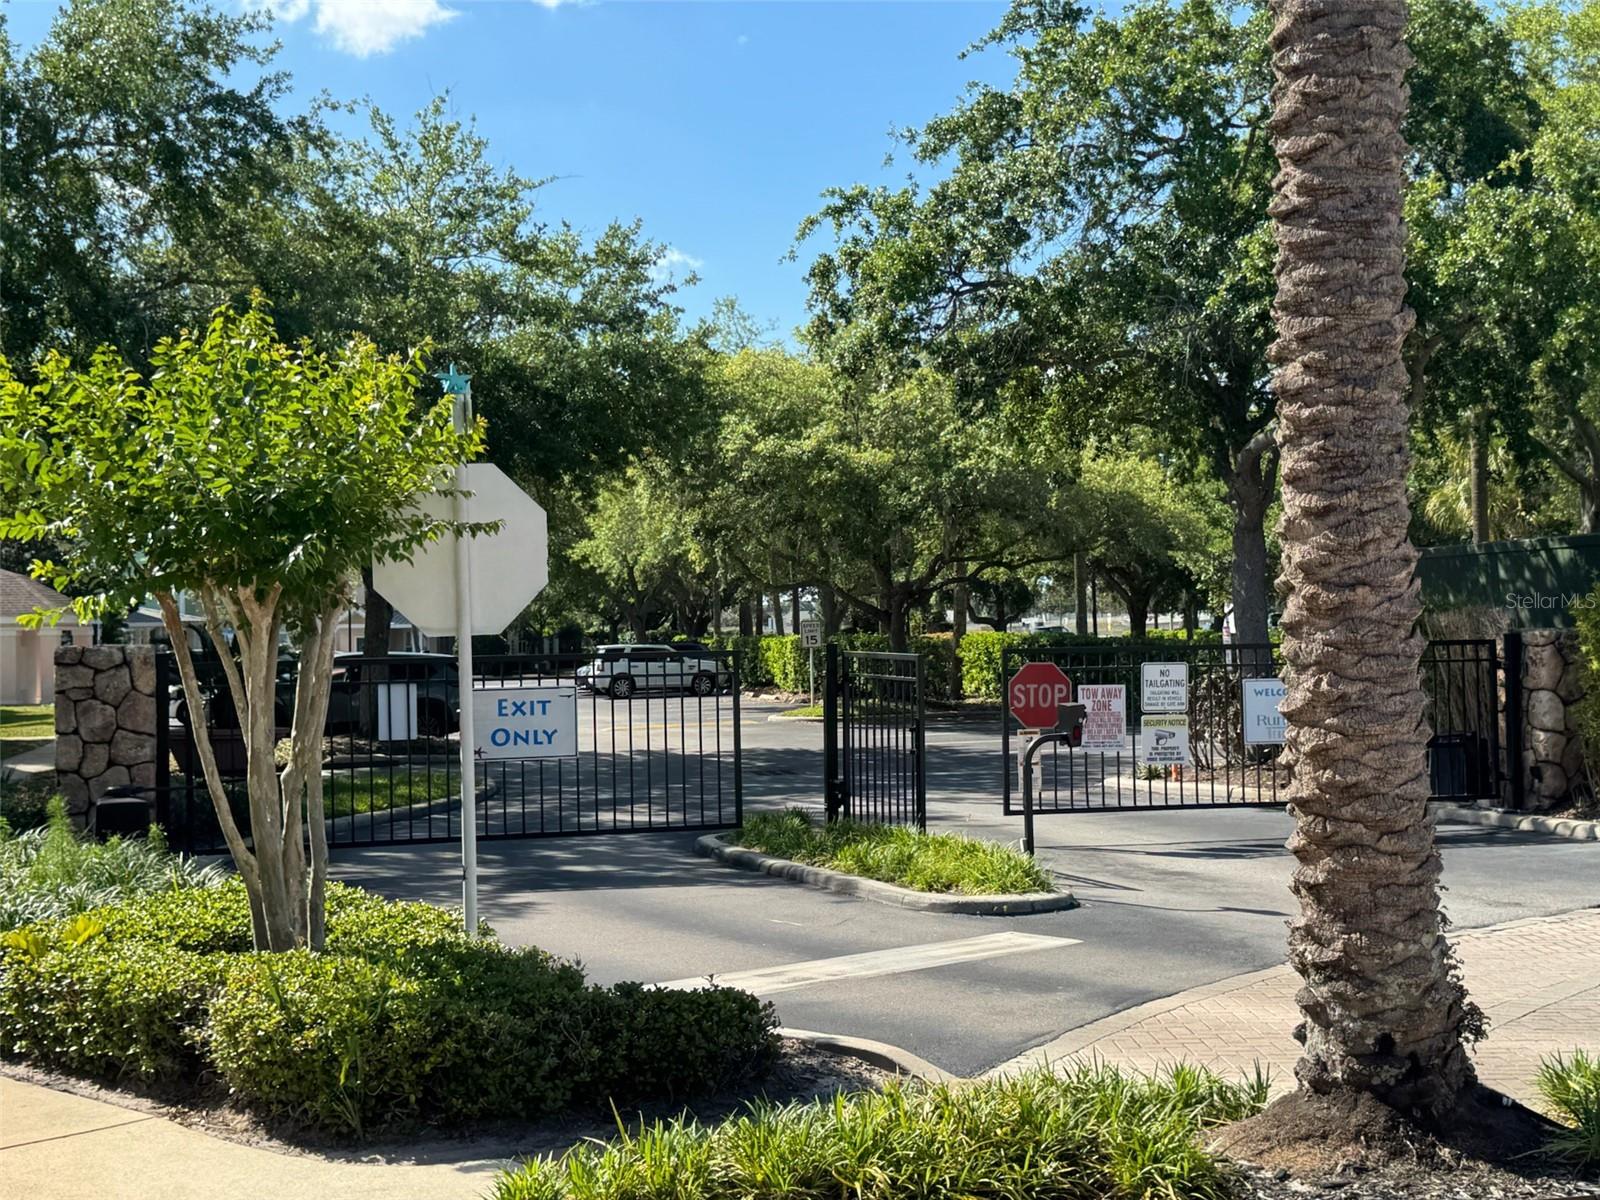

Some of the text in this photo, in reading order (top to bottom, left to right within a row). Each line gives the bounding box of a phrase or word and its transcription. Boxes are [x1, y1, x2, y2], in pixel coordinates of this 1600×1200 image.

[806, 635, 818, 645] 15
[1160, 669, 1170, 678] NO
[1145, 680, 1185, 688] TAILGATING
[1014, 684, 1067, 708] STOP
[1080, 688, 1122, 700] TOW AWAY
[497, 698, 552, 717] EXIT
[1092, 700, 1112, 711] ZONE
[490, 728, 557, 746] ONLY
